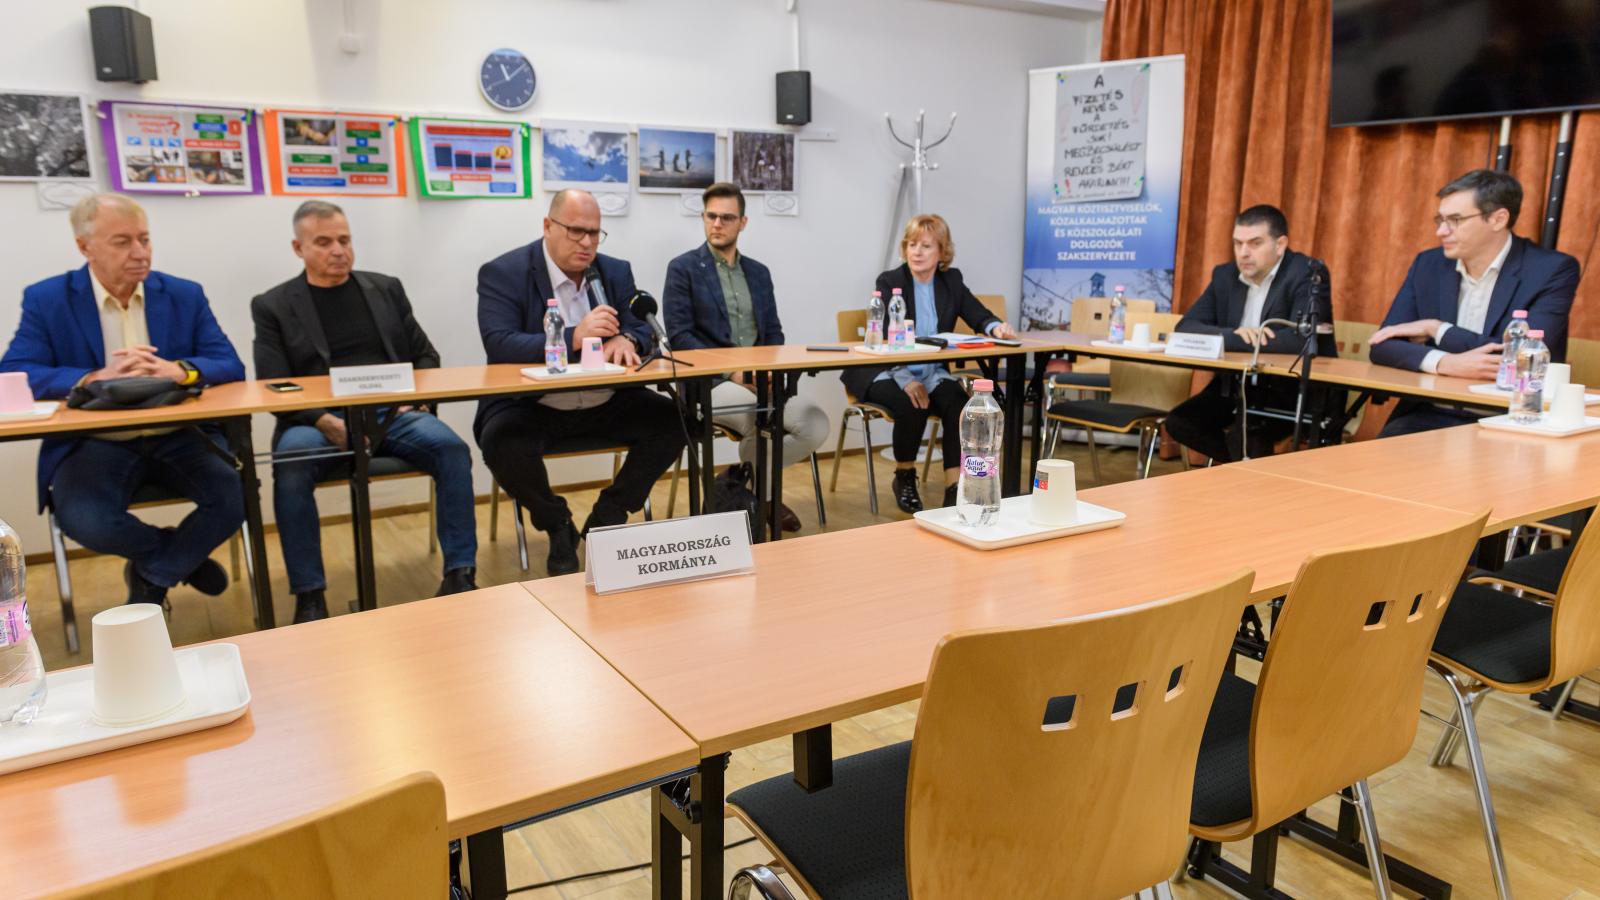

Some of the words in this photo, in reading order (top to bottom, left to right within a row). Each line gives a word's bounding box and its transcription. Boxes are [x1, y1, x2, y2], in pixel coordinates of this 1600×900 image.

[1094, 74, 1105, 88] A
[1038, 205, 1076, 215] MAGYAR
[1050, 215, 1148, 226] KÖZALKALMAZOTTAK
[1054, 227, 1066, 238] ÉS
[1067, 226, 1142, 238] KÖZSZOLGÁLATI
[1070, 239, 1125, 250] DOLGOZÓK
[1057, 251, 1137, 261] SZAKSZERVEZETE
[616, 534, 732, 561] MAGYARORSZÁG
[637, 555, 718, 576] KORMÁNYA
